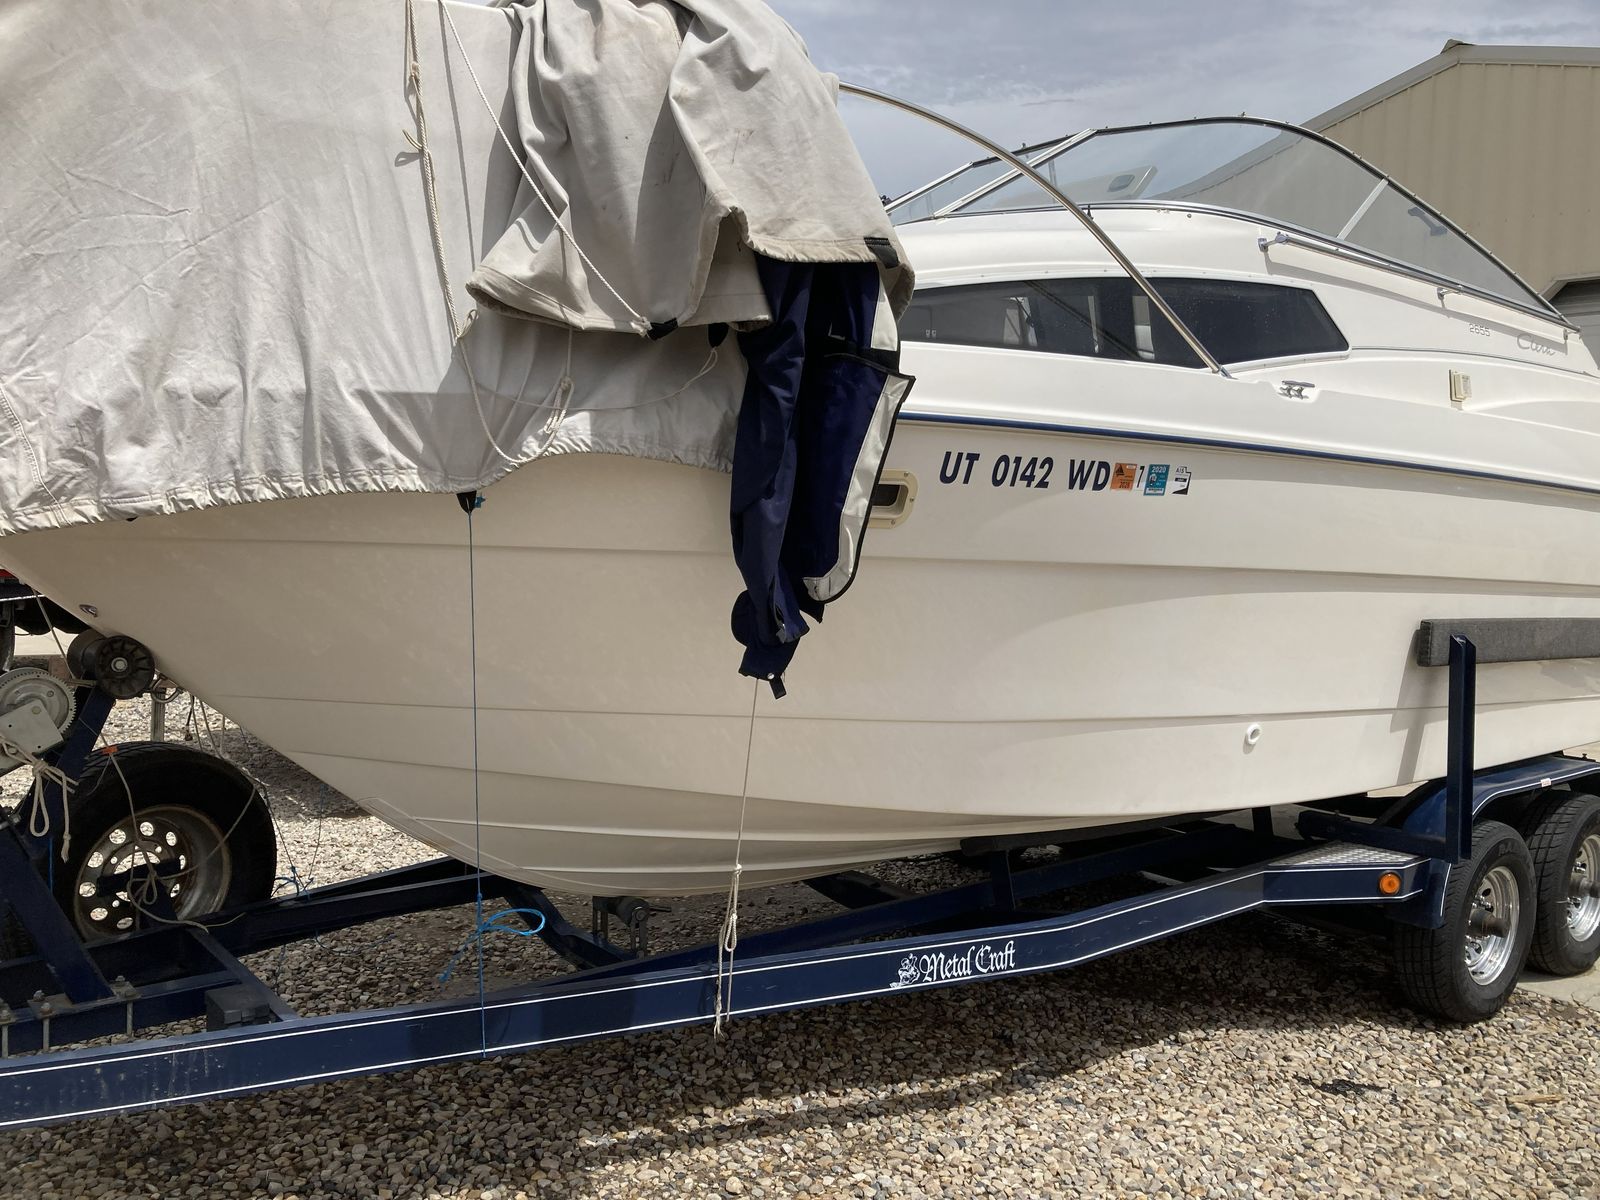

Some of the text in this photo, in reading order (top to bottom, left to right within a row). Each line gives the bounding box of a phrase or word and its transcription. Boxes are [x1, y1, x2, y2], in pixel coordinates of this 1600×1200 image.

[1469, 323, 1490, 336] 2655
[938, 451, 1110, 491] UT 0142 WD
[918, 940, 1016, 982] Metal Craft
